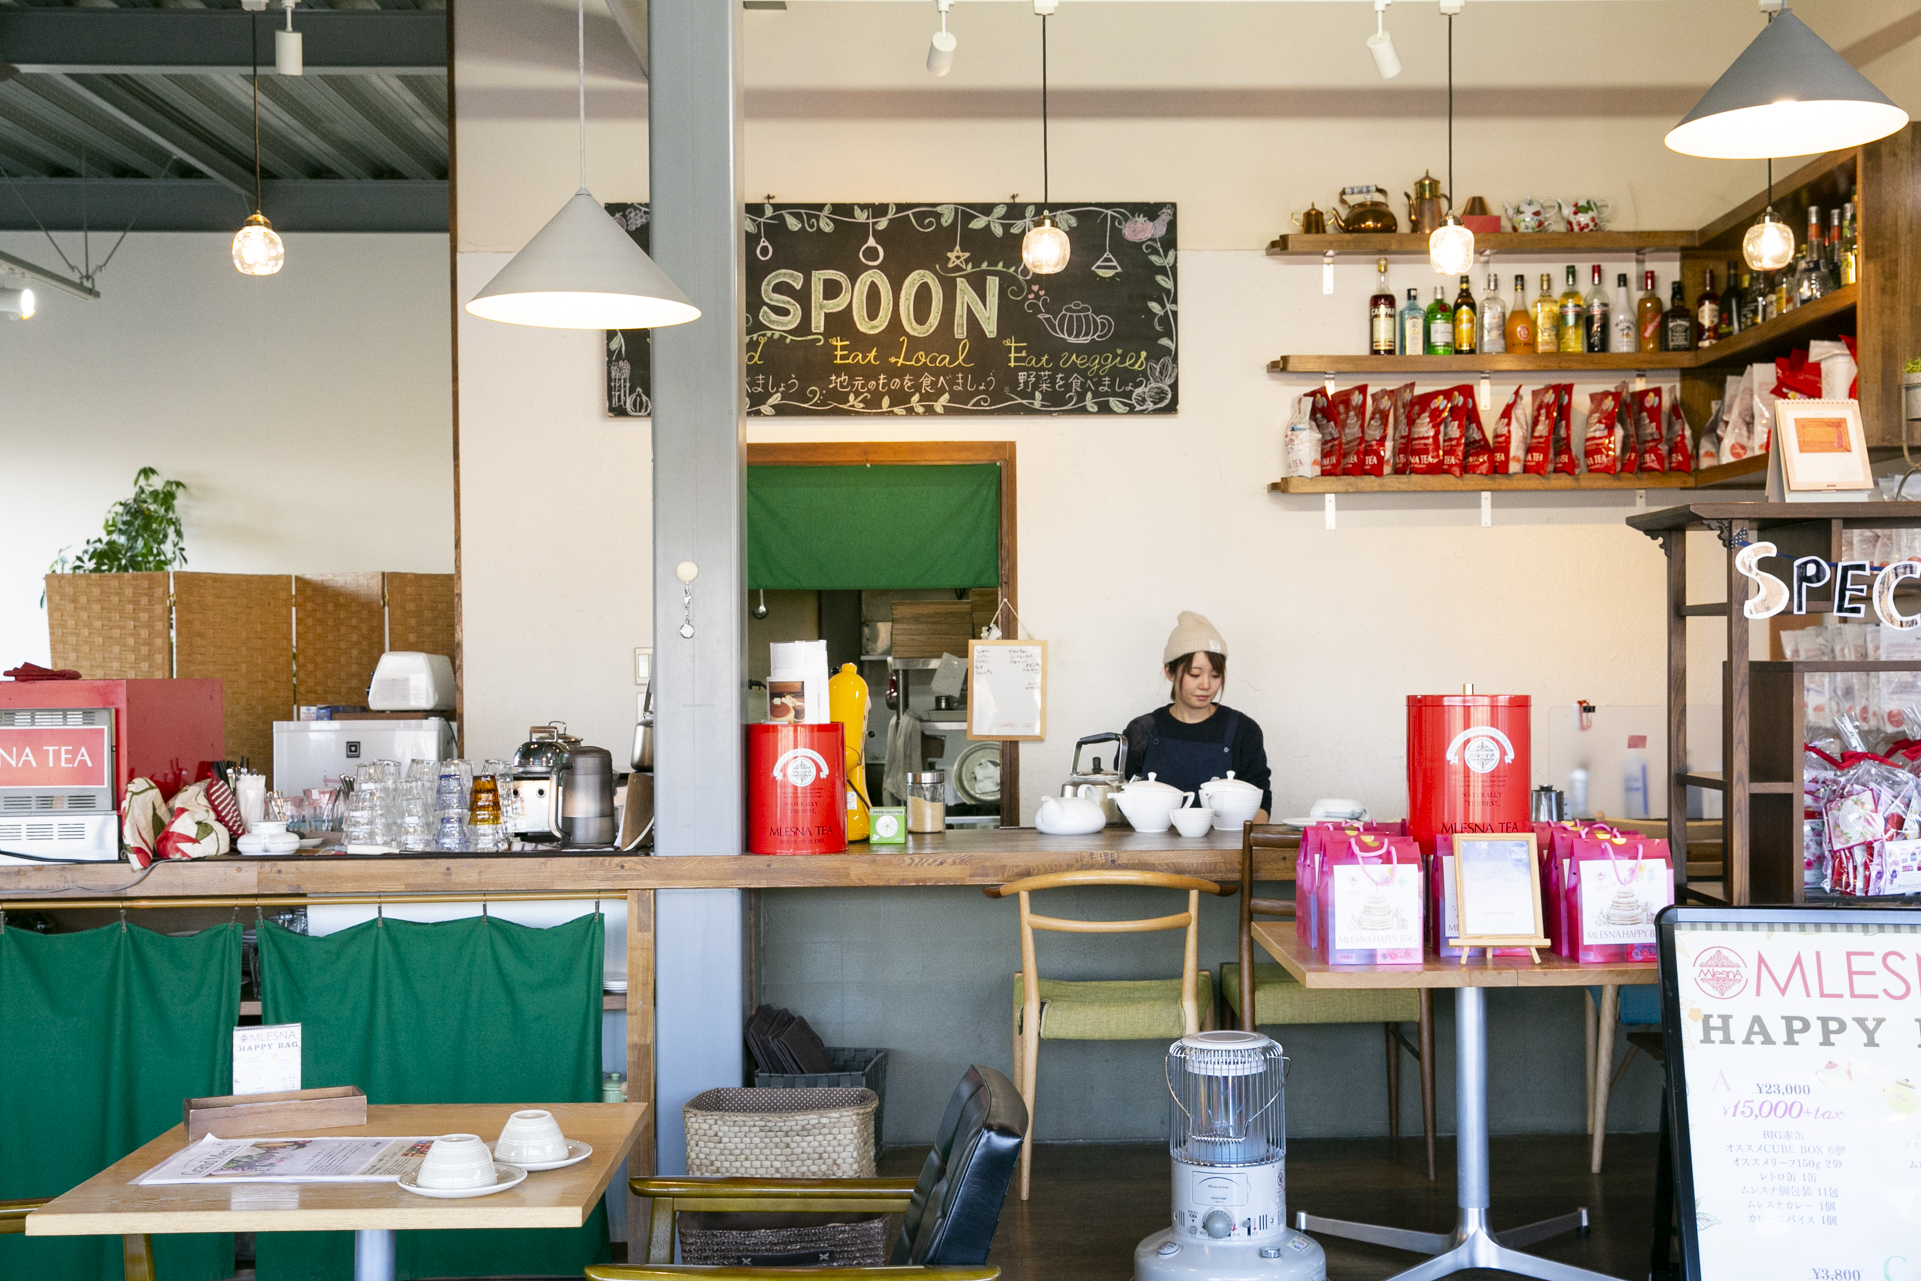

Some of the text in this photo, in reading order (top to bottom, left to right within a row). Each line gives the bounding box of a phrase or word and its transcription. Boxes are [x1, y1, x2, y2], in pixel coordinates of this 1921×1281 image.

[759, 268, 999, 339] SPOON
[829, 336, 975, 368] Eat Local
[1002, 335, 1148, 377] Eat veggies
[829, 371, 997, 394] 地元のものを食べましょう
[1016, 370, 1147, 393] 野菜を食べましょう
[42, 746, 93, 768] TEA
[769, 825, 834, 837] MLESNA TEA
[1440, 822, 1520, 834] MLESNA TEA
[1373, 935, 1398, 944] HAPPY
[1399, 934, 1417, 943] BAG
[1586, 930, 1621, 940] MLESNA
[1622, 930, 1649, 938] HAPPY
[249, 1030, 297, 1042] MLESNA
[1699, 1013, 1887, 1048] HAPPY
[238, 1041, 299, 1052] HAPPY BAG
[1754, 1082, 1811, 1096] ¥23,000
[1800, 1145, 1824, 1155] BOX
[1746, 1200, 1814, 1210] ムレスナカレー
